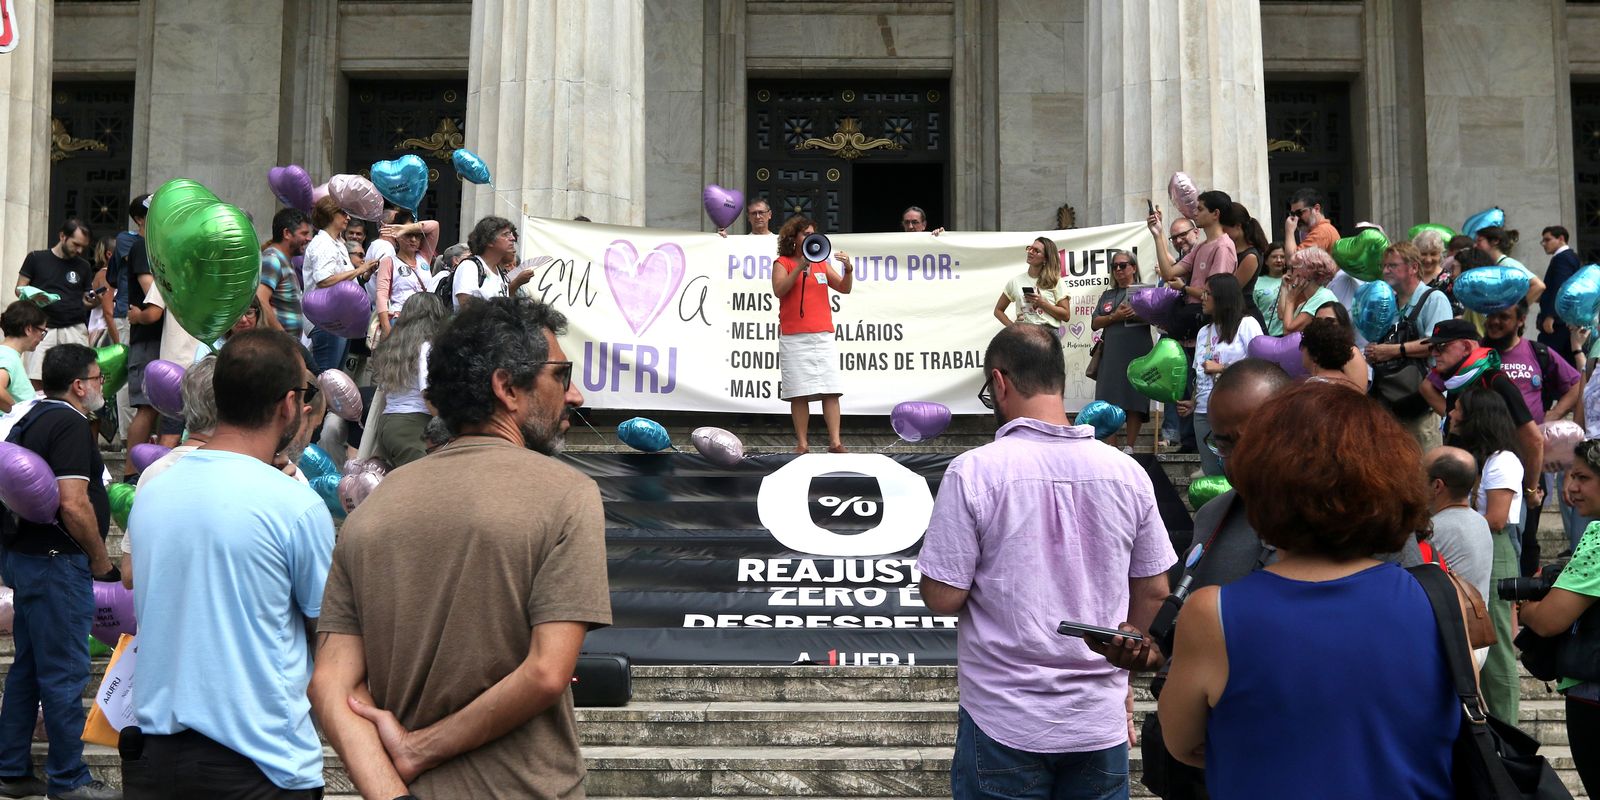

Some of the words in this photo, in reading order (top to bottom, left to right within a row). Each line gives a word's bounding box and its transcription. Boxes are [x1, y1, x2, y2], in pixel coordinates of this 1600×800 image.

[728, 254, 772, 280] POR
[842, 254, 898, 281] UTO
[907, 253, 960, 281] POR:
[732, 292, 773, 312] MAIS
[731, 321, 781, 341] MELH
[834, 319, 904, 341] ALÁRIOS
[582, 341, 678, 394] UFRJ
[731, 350, 780, 370] CONDI
[840, 352, 889, 371] IGNAS
[894, 352, 915, 371] DE
[920, 350, 984, 370] TRABAL
[1500, 363, 1527, 371] FENDO
[730, 379, 771, 399] MAIS
[737, 558, 921, 583] REAJUST
[768, 586, 887, 607] ZERO
